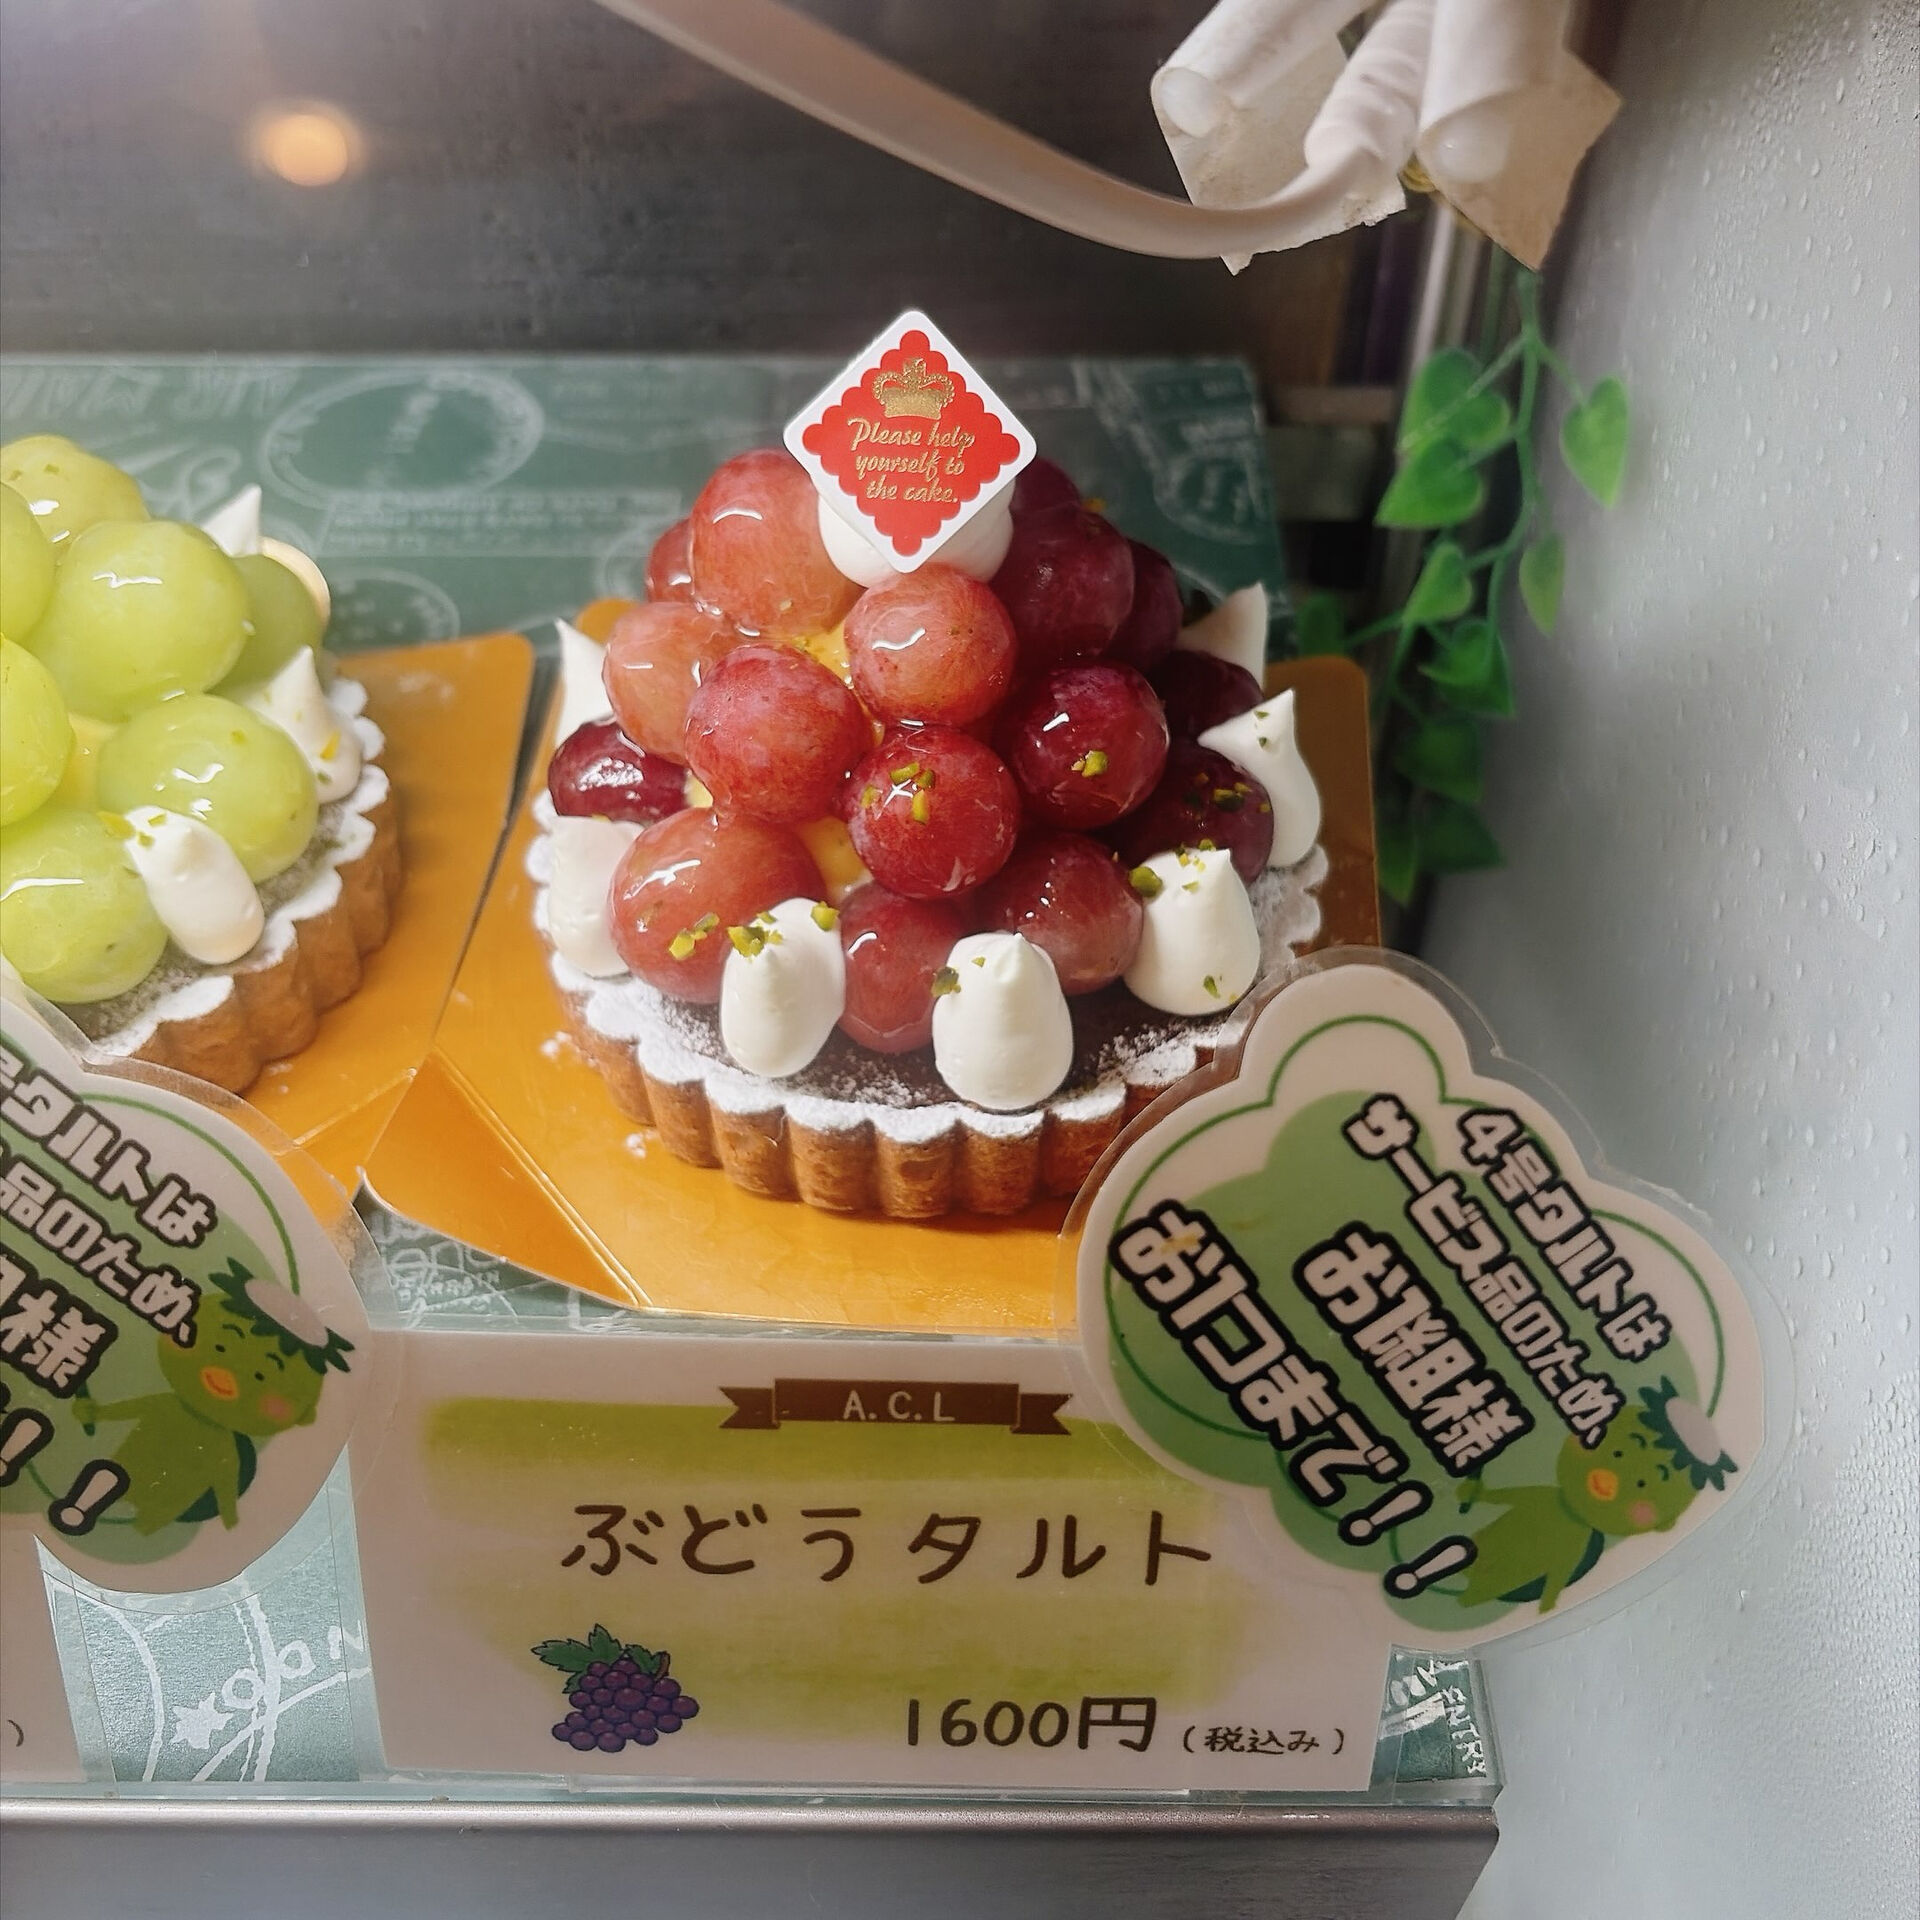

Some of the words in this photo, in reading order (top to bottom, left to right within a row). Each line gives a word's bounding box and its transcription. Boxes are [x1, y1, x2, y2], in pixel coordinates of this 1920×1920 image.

[847, 417, 922, 451] Please
[928, 421, 975, 458] help
[855, 450, 943, 481] yourself
[944, 456, 965, 476] to
[866, 475, 897, 500] the
[902, 479, 958, 503] cake.
[1458, 1108, 1672, 1363] 4号タルトは
[1341, 1093, 1627, 1451] サービス品のため、
[1292, 1220, 1536, 1478] お1組様
[842, 1389, 956, 1422] A.C.L
[560, 1503, 1212, 1586] ぶどうタルト
[907, 1697, 1157, 1752] 1600円
